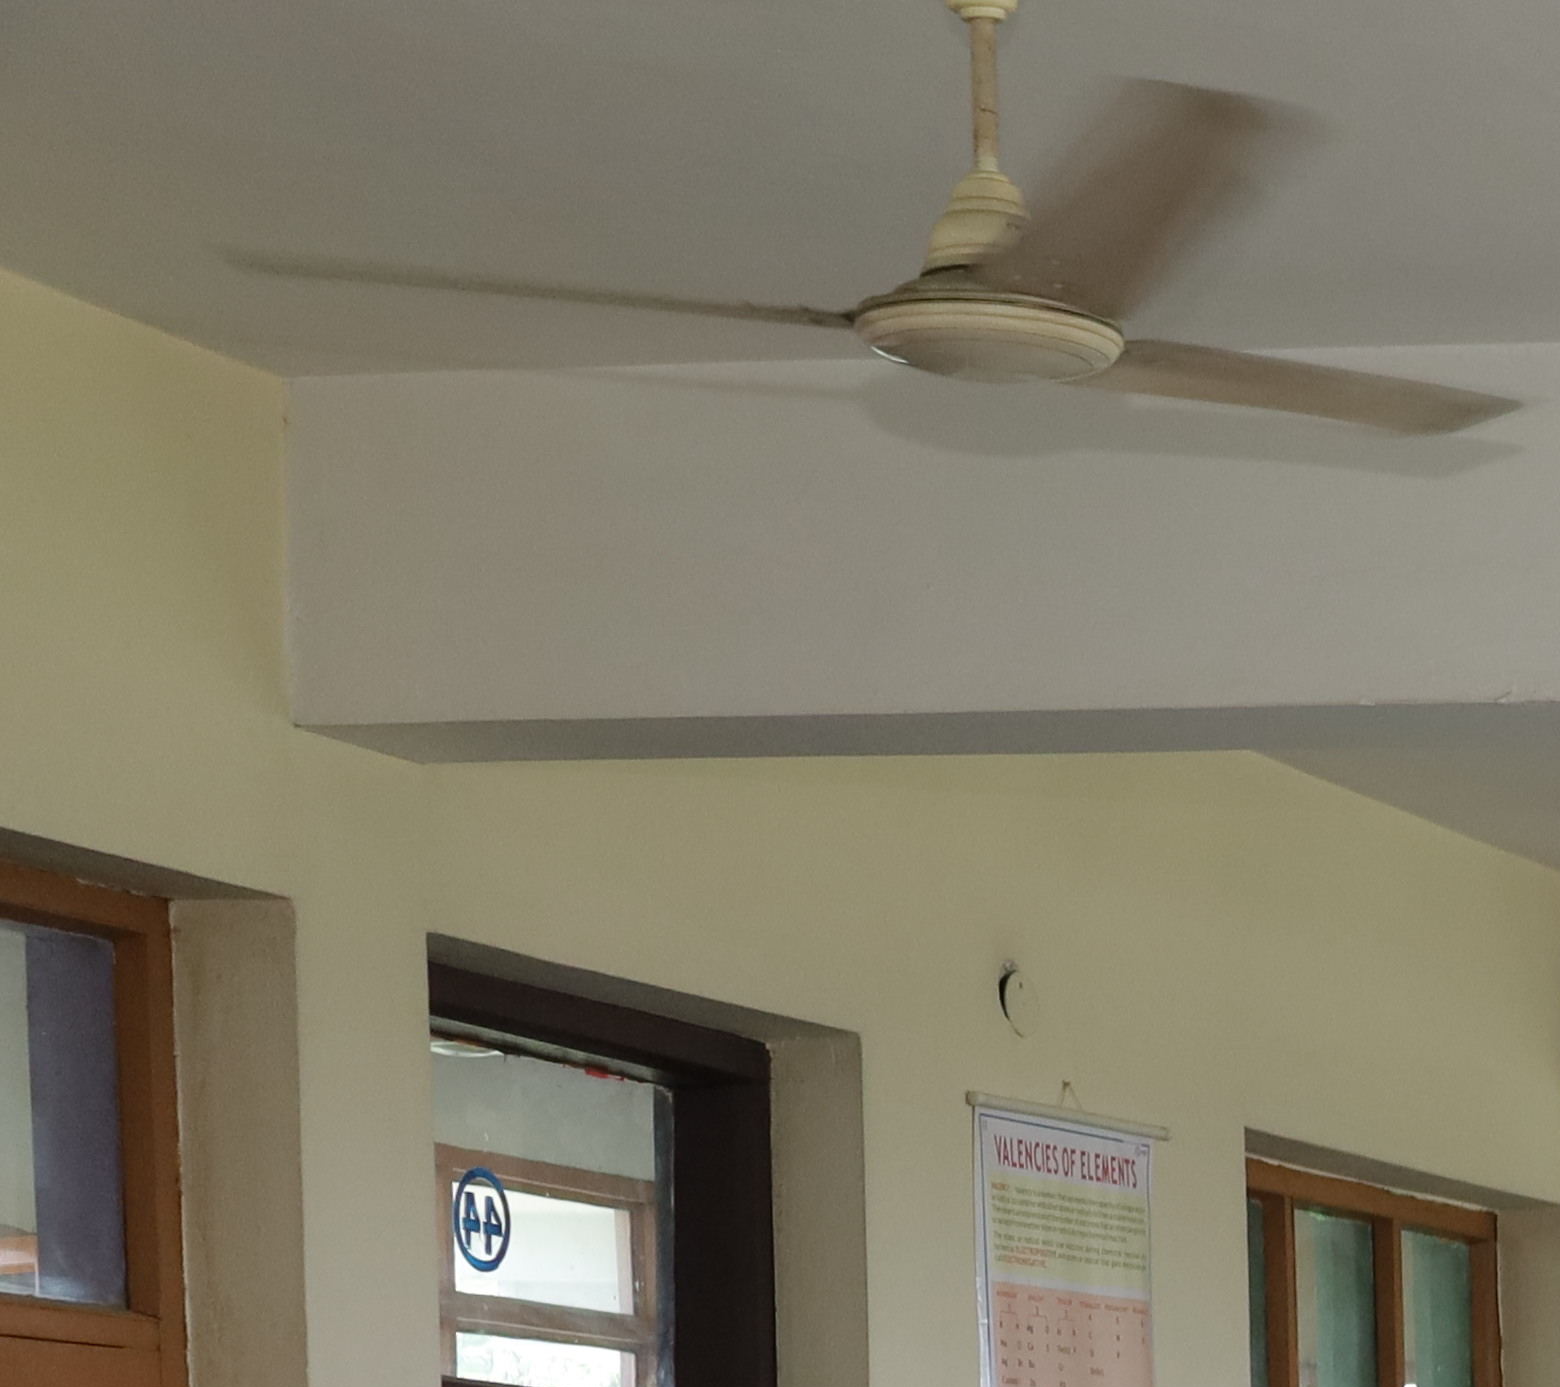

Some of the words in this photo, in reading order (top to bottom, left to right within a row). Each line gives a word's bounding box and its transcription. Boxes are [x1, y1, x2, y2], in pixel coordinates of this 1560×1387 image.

[994, 1134, 1059, 1175] VALENCIES
[1061, 1147, 1076, 1177] OF
[1080, 1151, 1137, 1188] ELEMENTS
